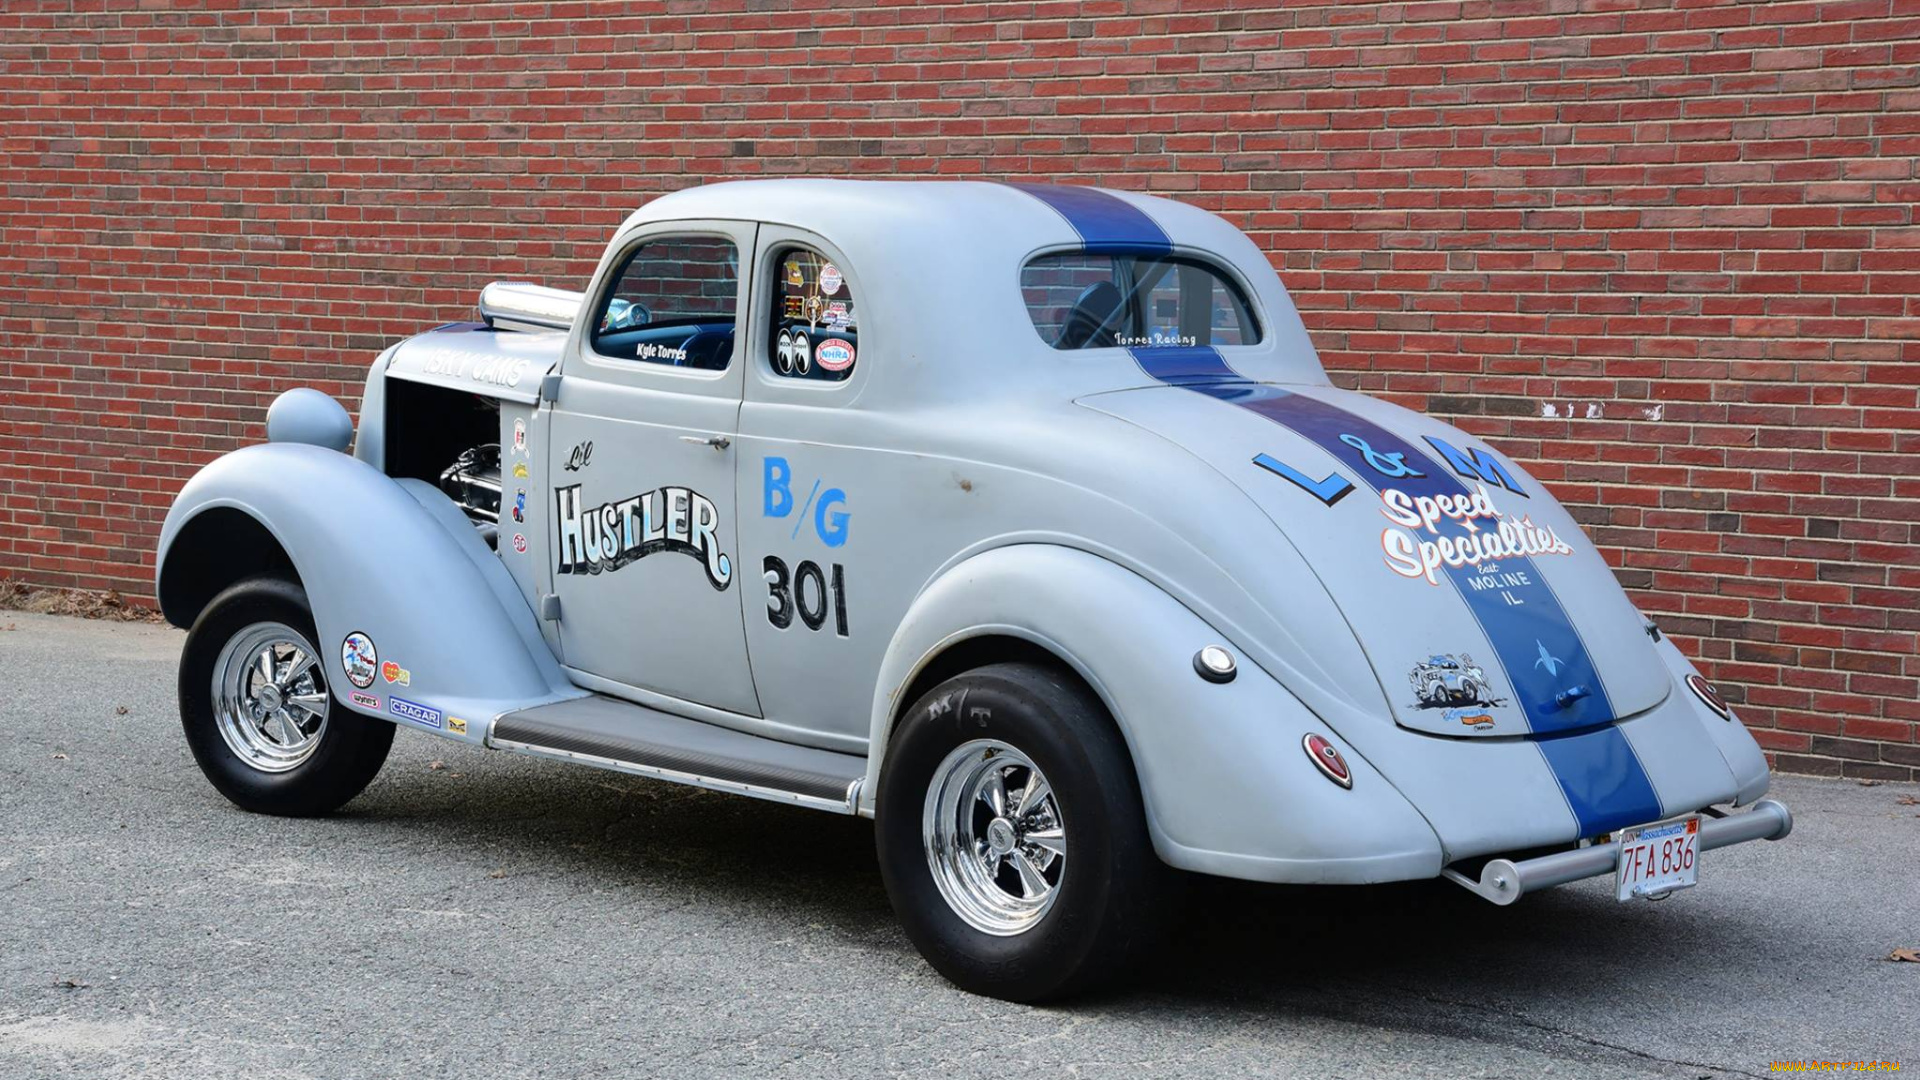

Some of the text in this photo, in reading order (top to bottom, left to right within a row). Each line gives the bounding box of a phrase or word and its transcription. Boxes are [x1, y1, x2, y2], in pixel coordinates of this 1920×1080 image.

[636, 343, 687, 360] Kyle Torres
[821, 350, 848, 359] NHRA
[1114, 332, 1196, 347] Torres Racing
[423, 349, 531, 388] ISKY CAMS
[1252, 433, 1530, 508] L & M
[761, 456, 852, 548] B/G
[1379, 484, 1503, 534] Speed
[1380, 514, 1575, 587] Specialties
[1477, 563, 1500, 575] East
[762, 555, 850, 639] 301
[1467, 571, 1532, 591] MOLINE
[391, 702, 438, 723] CRAGAR
[1622, 836, 1695, 884] 7FA 836
